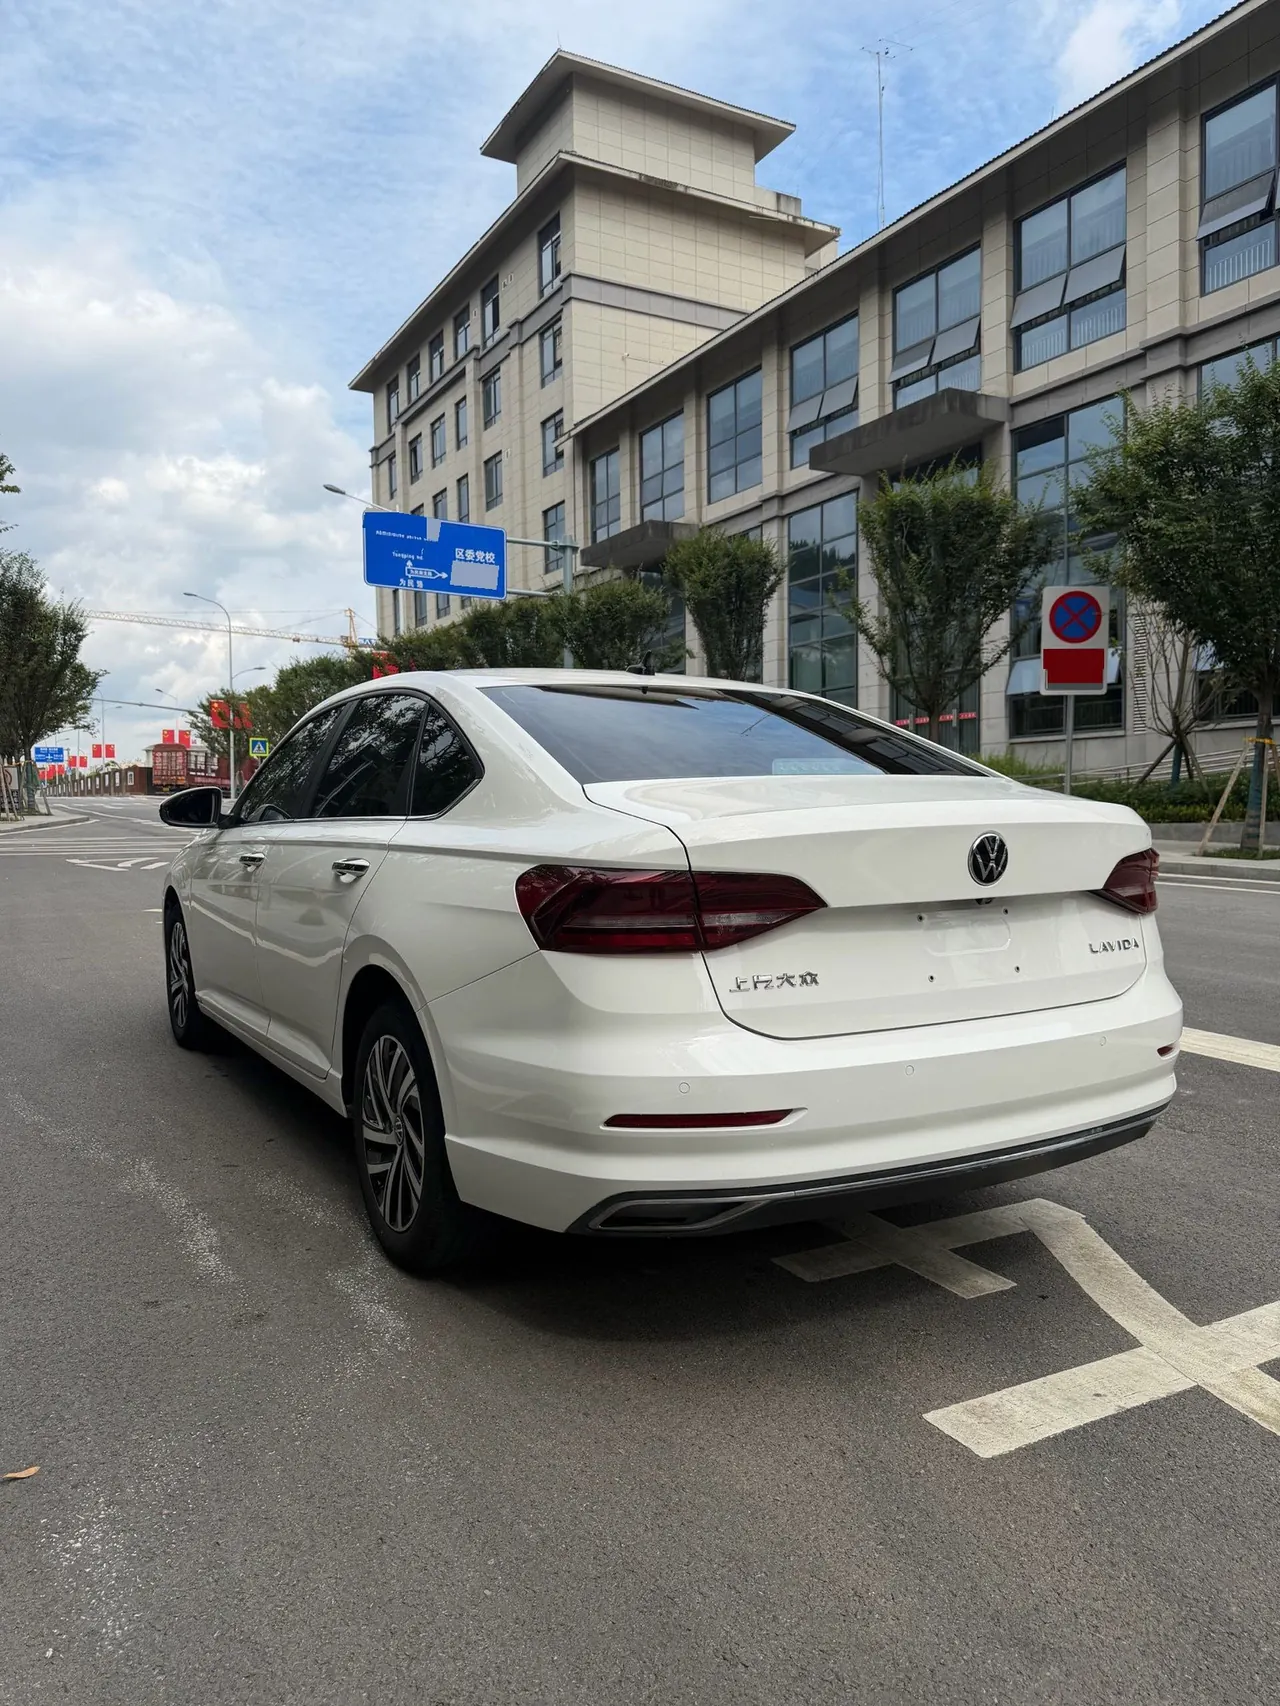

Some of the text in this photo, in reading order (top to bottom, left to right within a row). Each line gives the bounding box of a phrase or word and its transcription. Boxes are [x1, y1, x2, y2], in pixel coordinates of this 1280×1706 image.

[455, 548, 495, 563] 区委党校
[1088, 937, 1139, 954] LAVIDA
